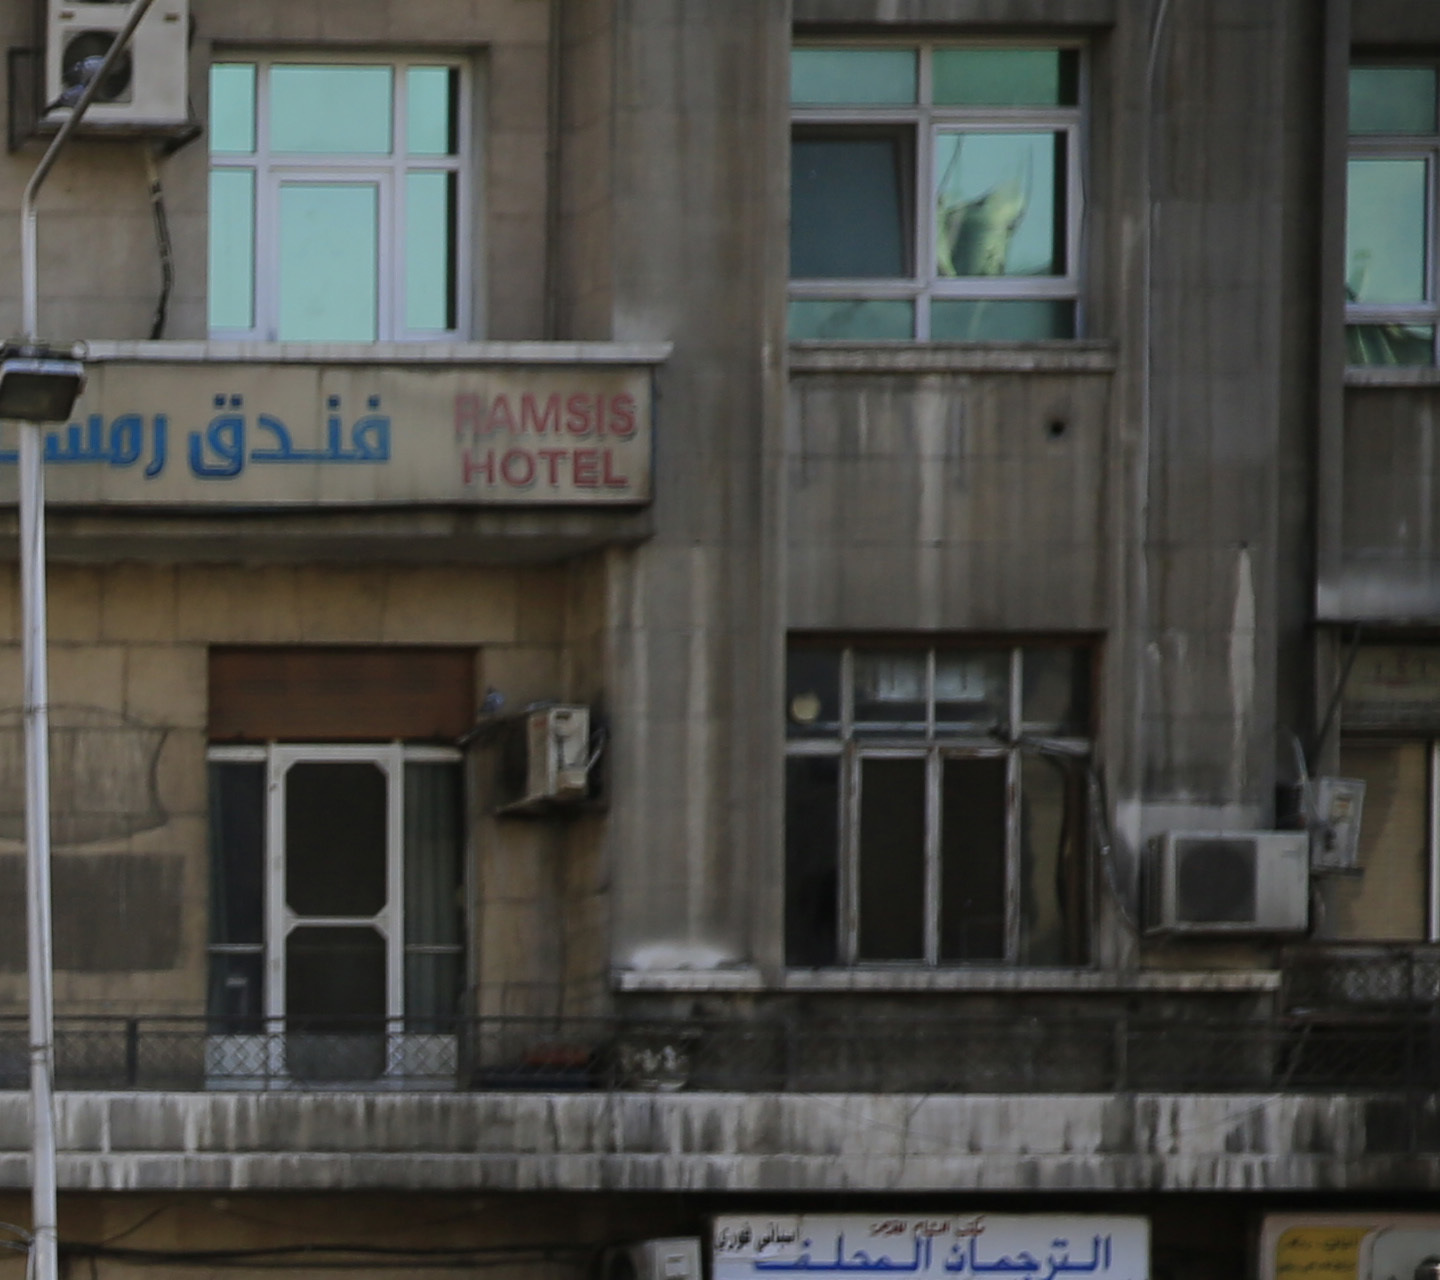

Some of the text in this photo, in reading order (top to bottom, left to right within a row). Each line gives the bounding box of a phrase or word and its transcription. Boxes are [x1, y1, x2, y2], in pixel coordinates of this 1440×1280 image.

[454, 393, 637, 435] RAMSIS
[188, 393, 391, 479] فندق
[463, 447, 629, 488] HOTEL
[755, 1231, 932, 1271] المحلف
